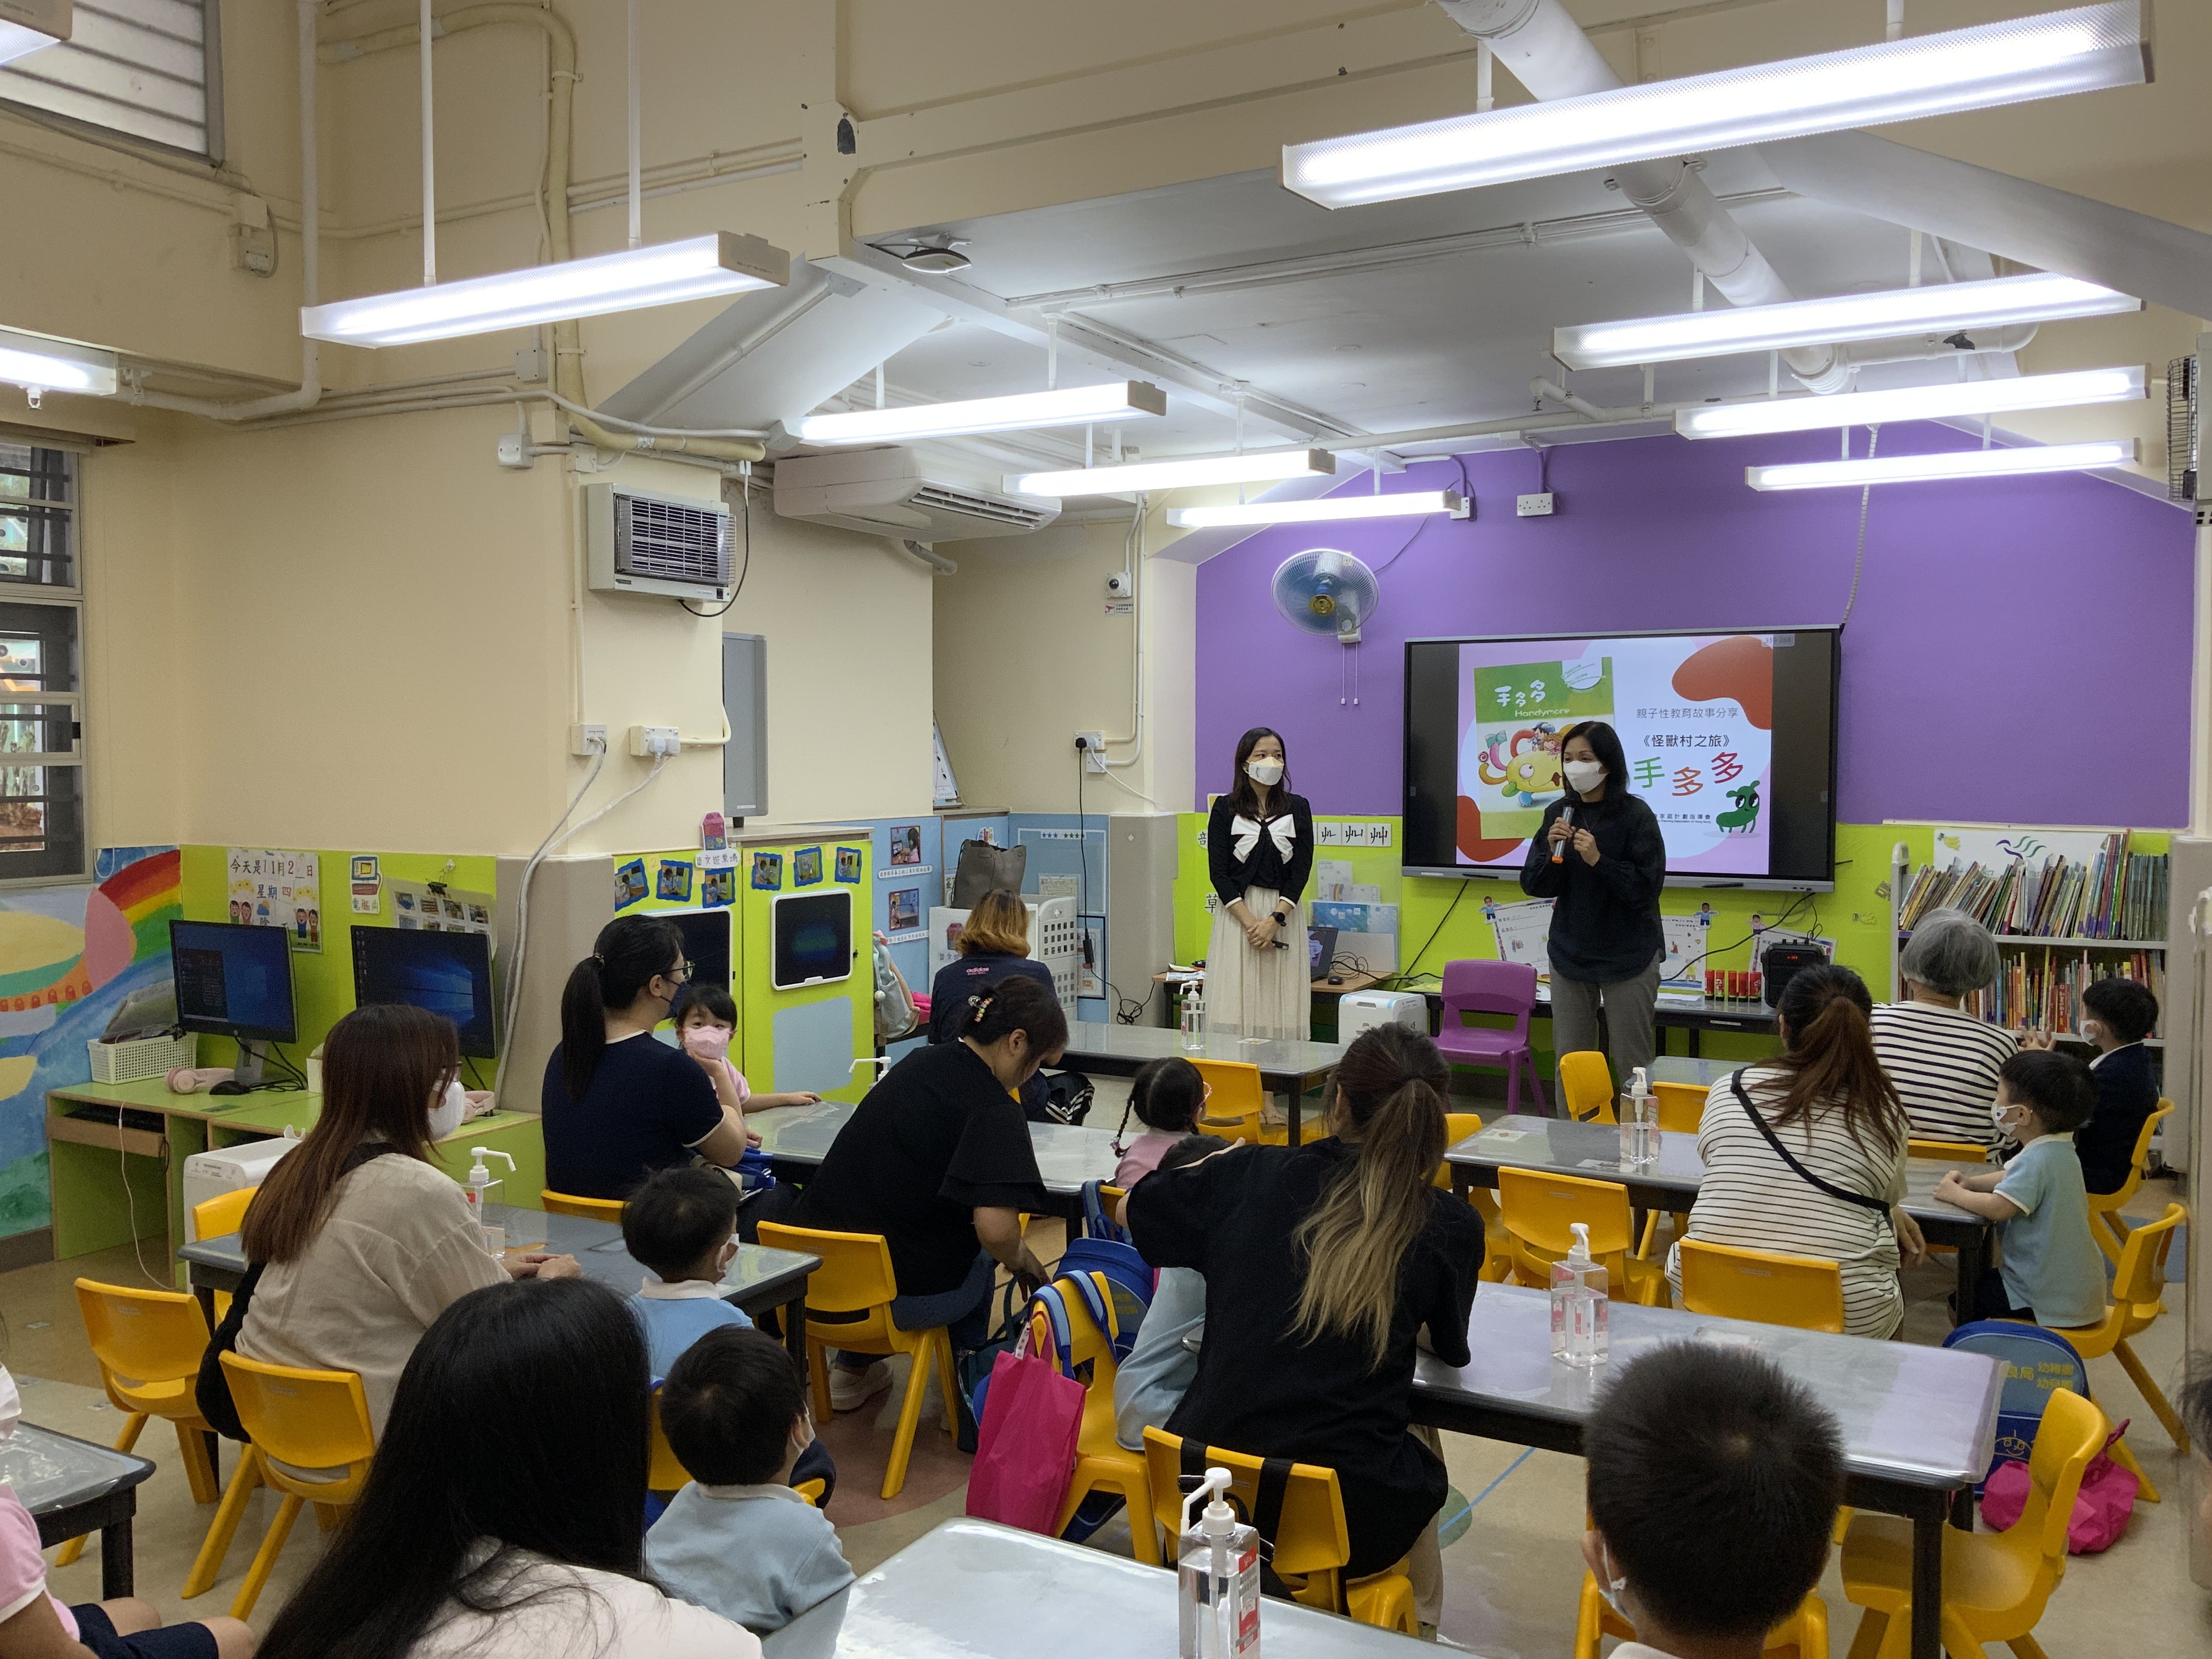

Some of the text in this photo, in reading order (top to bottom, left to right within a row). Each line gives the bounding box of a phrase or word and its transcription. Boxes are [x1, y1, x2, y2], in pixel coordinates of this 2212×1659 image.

[1494, 680, 1545, 707] 手多多
[1515, 708, 1570, 717] Handymore
[1637, 707, 1739, 719] 親子性教育故事分享
[1643, 734, 1730, 747] 《怪獸村之旅》
[1633, 752, 1743, 796] 手多多
[257, 884, 292, 900] 星期四
[1205, 894, 1218, 913] 草
